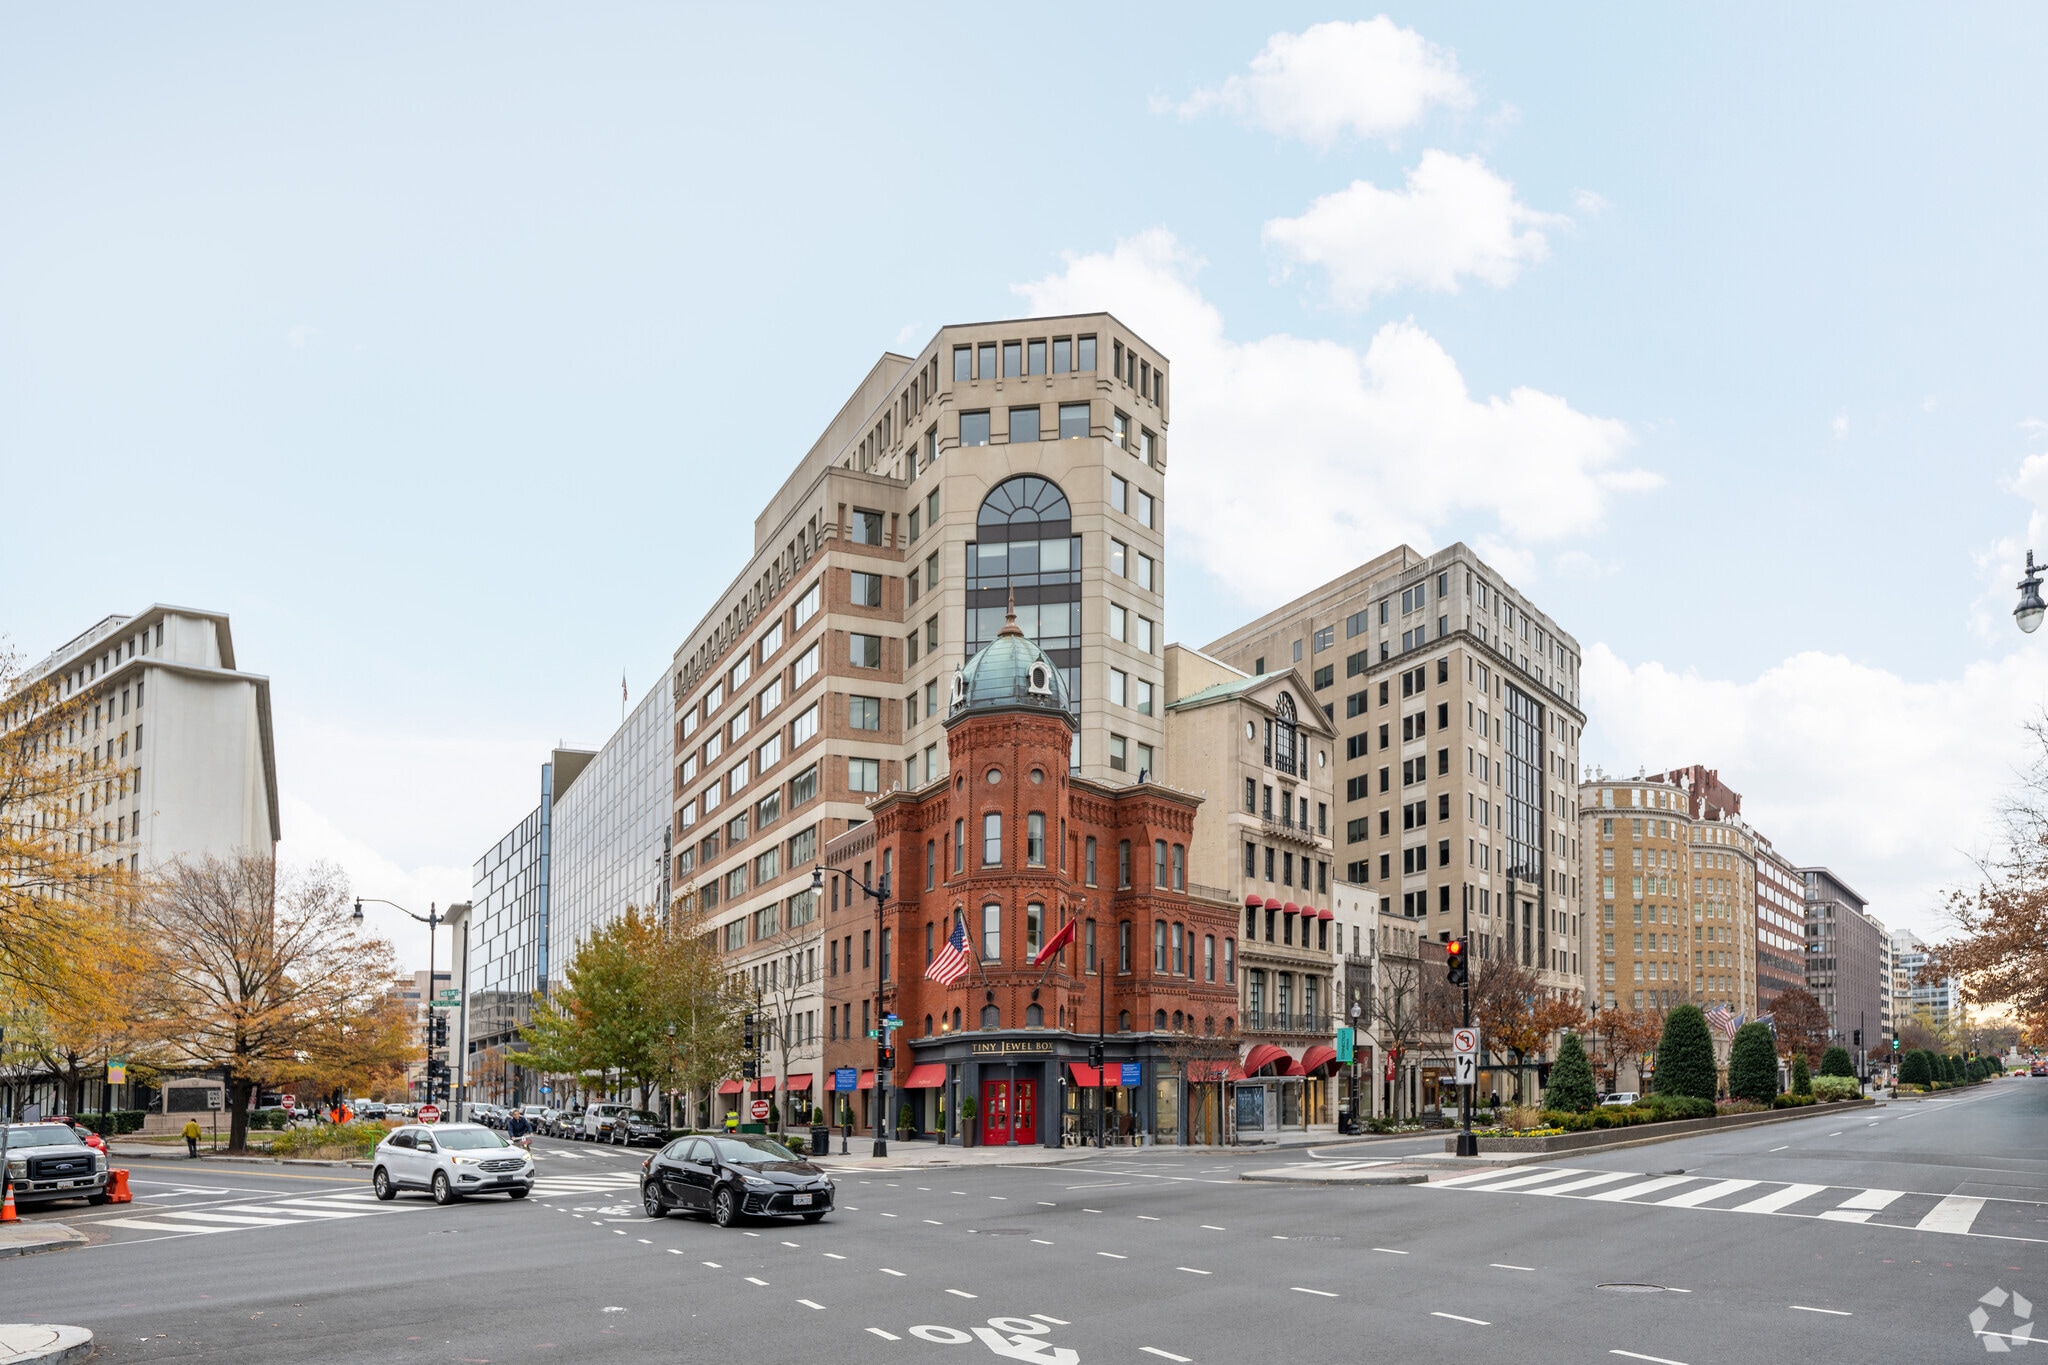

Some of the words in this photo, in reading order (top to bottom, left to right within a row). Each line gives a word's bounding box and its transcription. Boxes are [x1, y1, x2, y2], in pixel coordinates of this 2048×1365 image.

[972, 1043, 996, 1051] TINY
[1001, 1041, 1032, 1056] JEWEL
[1036, 1042, 1053, 1050] BOX
